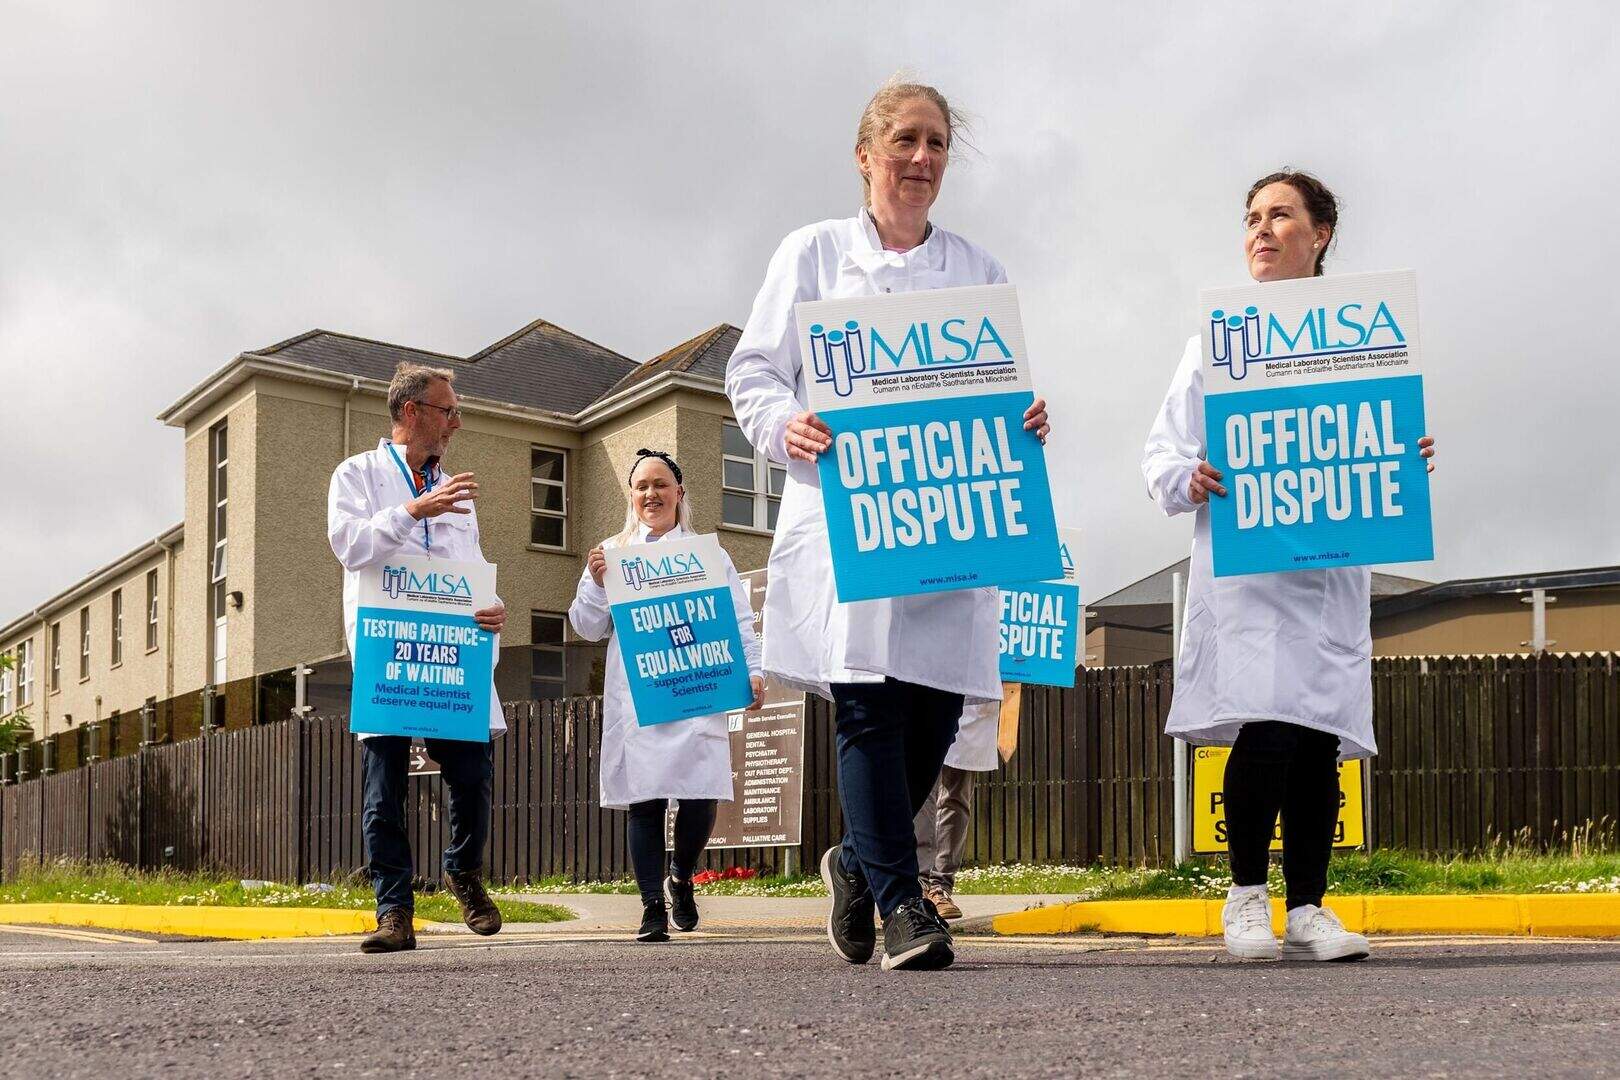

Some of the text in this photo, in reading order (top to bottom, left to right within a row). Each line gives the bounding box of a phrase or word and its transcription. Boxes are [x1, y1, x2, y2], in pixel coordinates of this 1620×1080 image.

[1265, 301, 1406, 354] MLSA
[869, 316, 1013, 371] MLSA
[1265, 350, 1409, 370] Medical Laboratory Scientists Association
[871, 366, 1017, 386] Medical Laboratory Scientists Association
[1265, 369, 1293, 378] Cumann
[872, 385, 900, 394] Cumann
[1225, 400, 1406, 470] OFFICIAL
[835, 416, 1023, 490] OFFICIAL
[1234, 461, 1404, 530] DISPUTE
[850, 478, 1028, 552] DISPUTE
[646, 552, 704, 579] MLSA
[1293, 551, 1350, 562] www.mlsa.ie
[407, 571, 472, 596] MLSA
[919, 572, 978, 586] www.mlsa.ie
[630, 601, 685, 634] EQUAL
[684, 595, 717, 624] PAY
[999, 590, 1067, 627] FICIAL
[362, 618, 417, 642] TESTING
[670, 625, 694, 647] FOR
[998, 623, 1063, 660] SPUTE
[395, 641, 458, 665] 20 YEARS
[635, 640, 734, 679] EQUAL WORK
[386, 663, 465, 686] OF WAITING
[654, 673, 694, 689] support
[694, 666, 733, 681] Medical
[375, 682, 472, 700] Medical Scientist
[671, 682, 718, 697] Scientists
[371, 696, 474, 714] deserve equal pay
[746, 728, 797, 740] GENERAL HOSPITAL
[745, 740, 766, 749] DENTAL
[745, 749, 778, 758] PSYCHIATRY
[744, 758, 788, 768] PHYSIOTHERAPY
[744, 769, 756, 777] OUT
[756, 768, 778, 776] PATIENT
[778, 766, 794, 774] DEPT.
[743, 786, 782, 796] MAINTENANCE
[744, 777, 789, 787] ADMINISTRATION
[743, 796, 776, 805] AMBULANCE
[743, 806, 778, 815] LABORATORY
[743, 816, 768, 824] SUPPLIES
[742, 833, 787, 843] PALLIATIVE CARE
